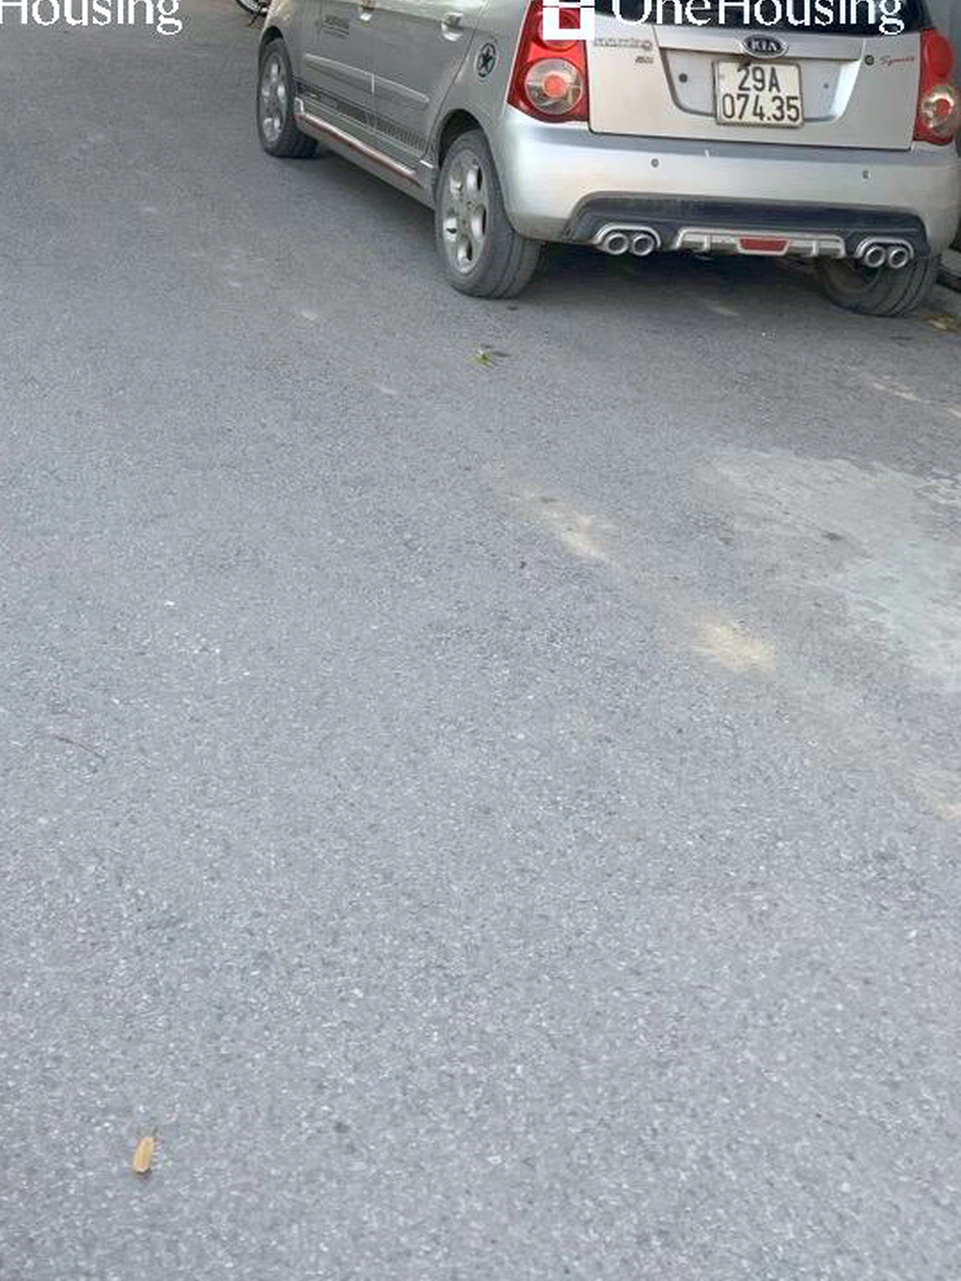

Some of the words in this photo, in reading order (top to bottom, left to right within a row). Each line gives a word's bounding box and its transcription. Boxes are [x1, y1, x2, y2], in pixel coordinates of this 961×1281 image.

[751, 40, 778, 51] KIA
[737, 66, 781, 92] 29A
[722, 93, 800, 122] 074.35
